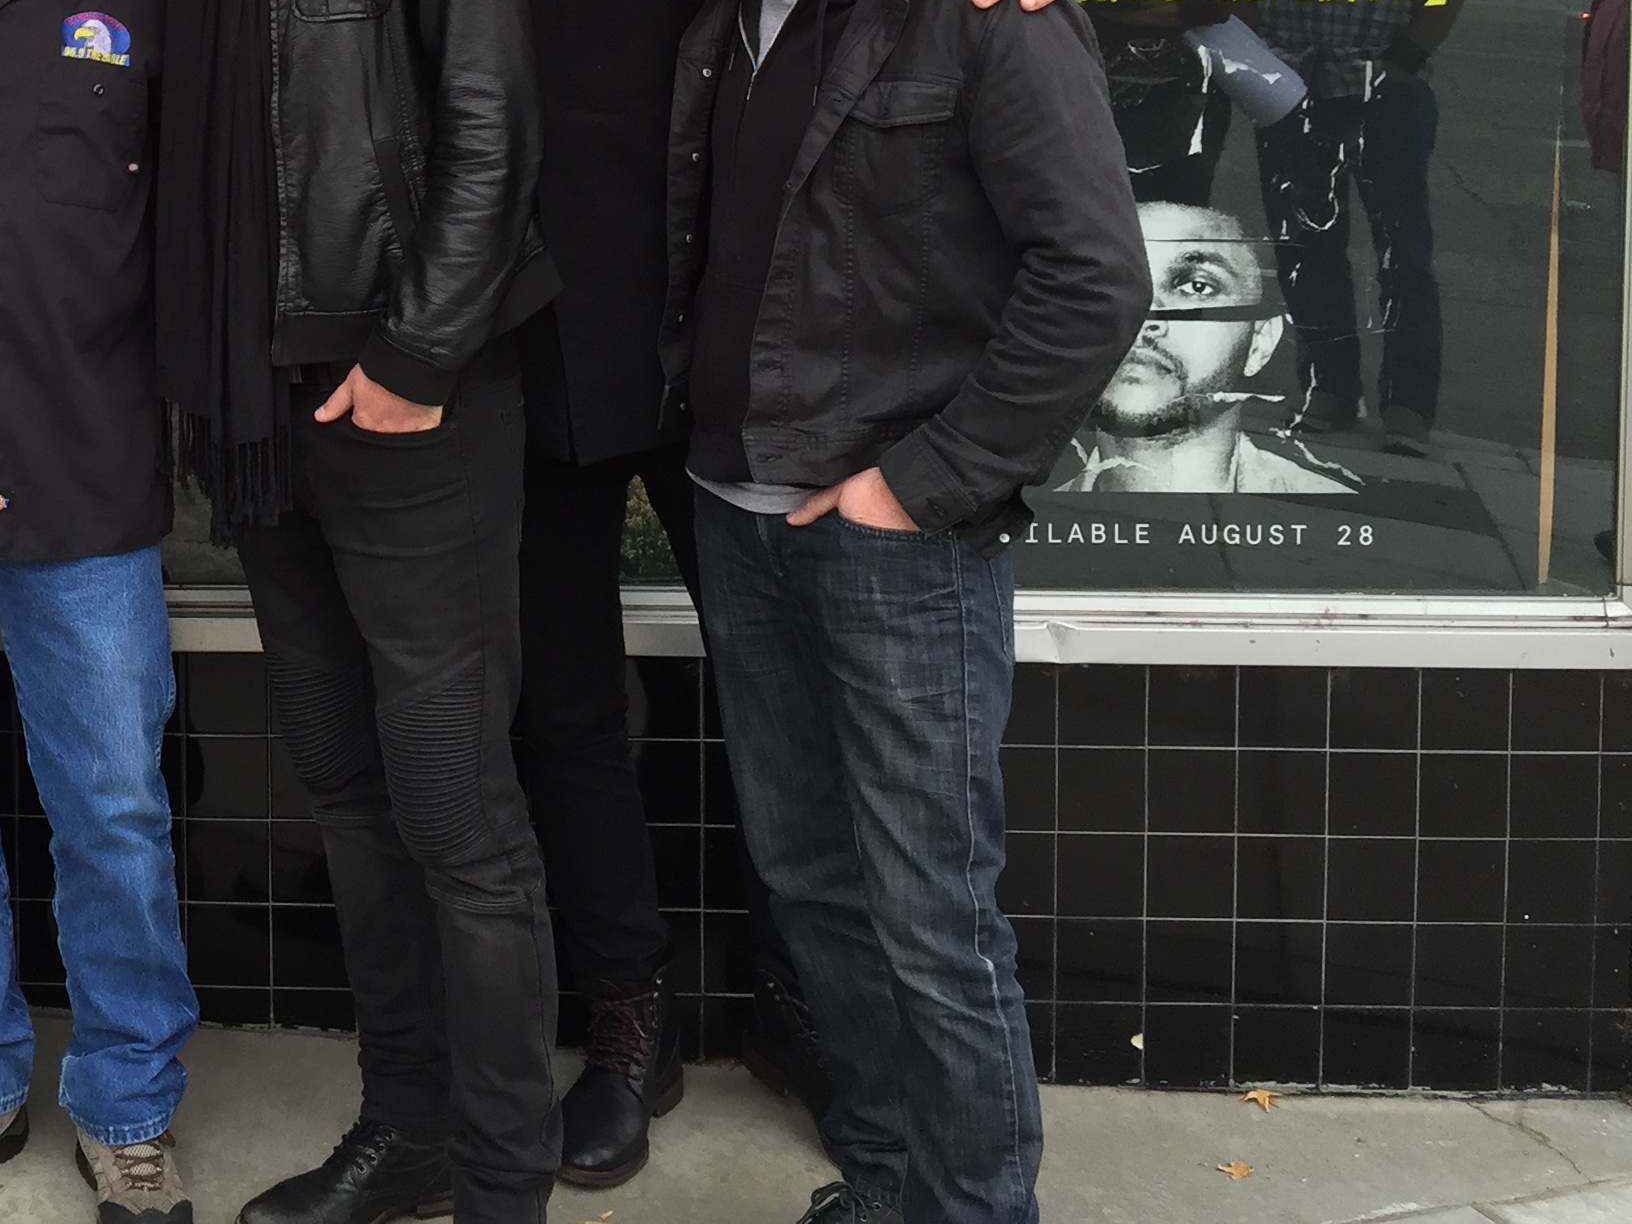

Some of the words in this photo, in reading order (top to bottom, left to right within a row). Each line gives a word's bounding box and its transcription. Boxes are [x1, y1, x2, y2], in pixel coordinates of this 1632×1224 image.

[1025, 522, 1151, 545] ILABLE
[1178, 523, 1309, 547] AUGUST
[1336, 524, 1375, 546] 28
